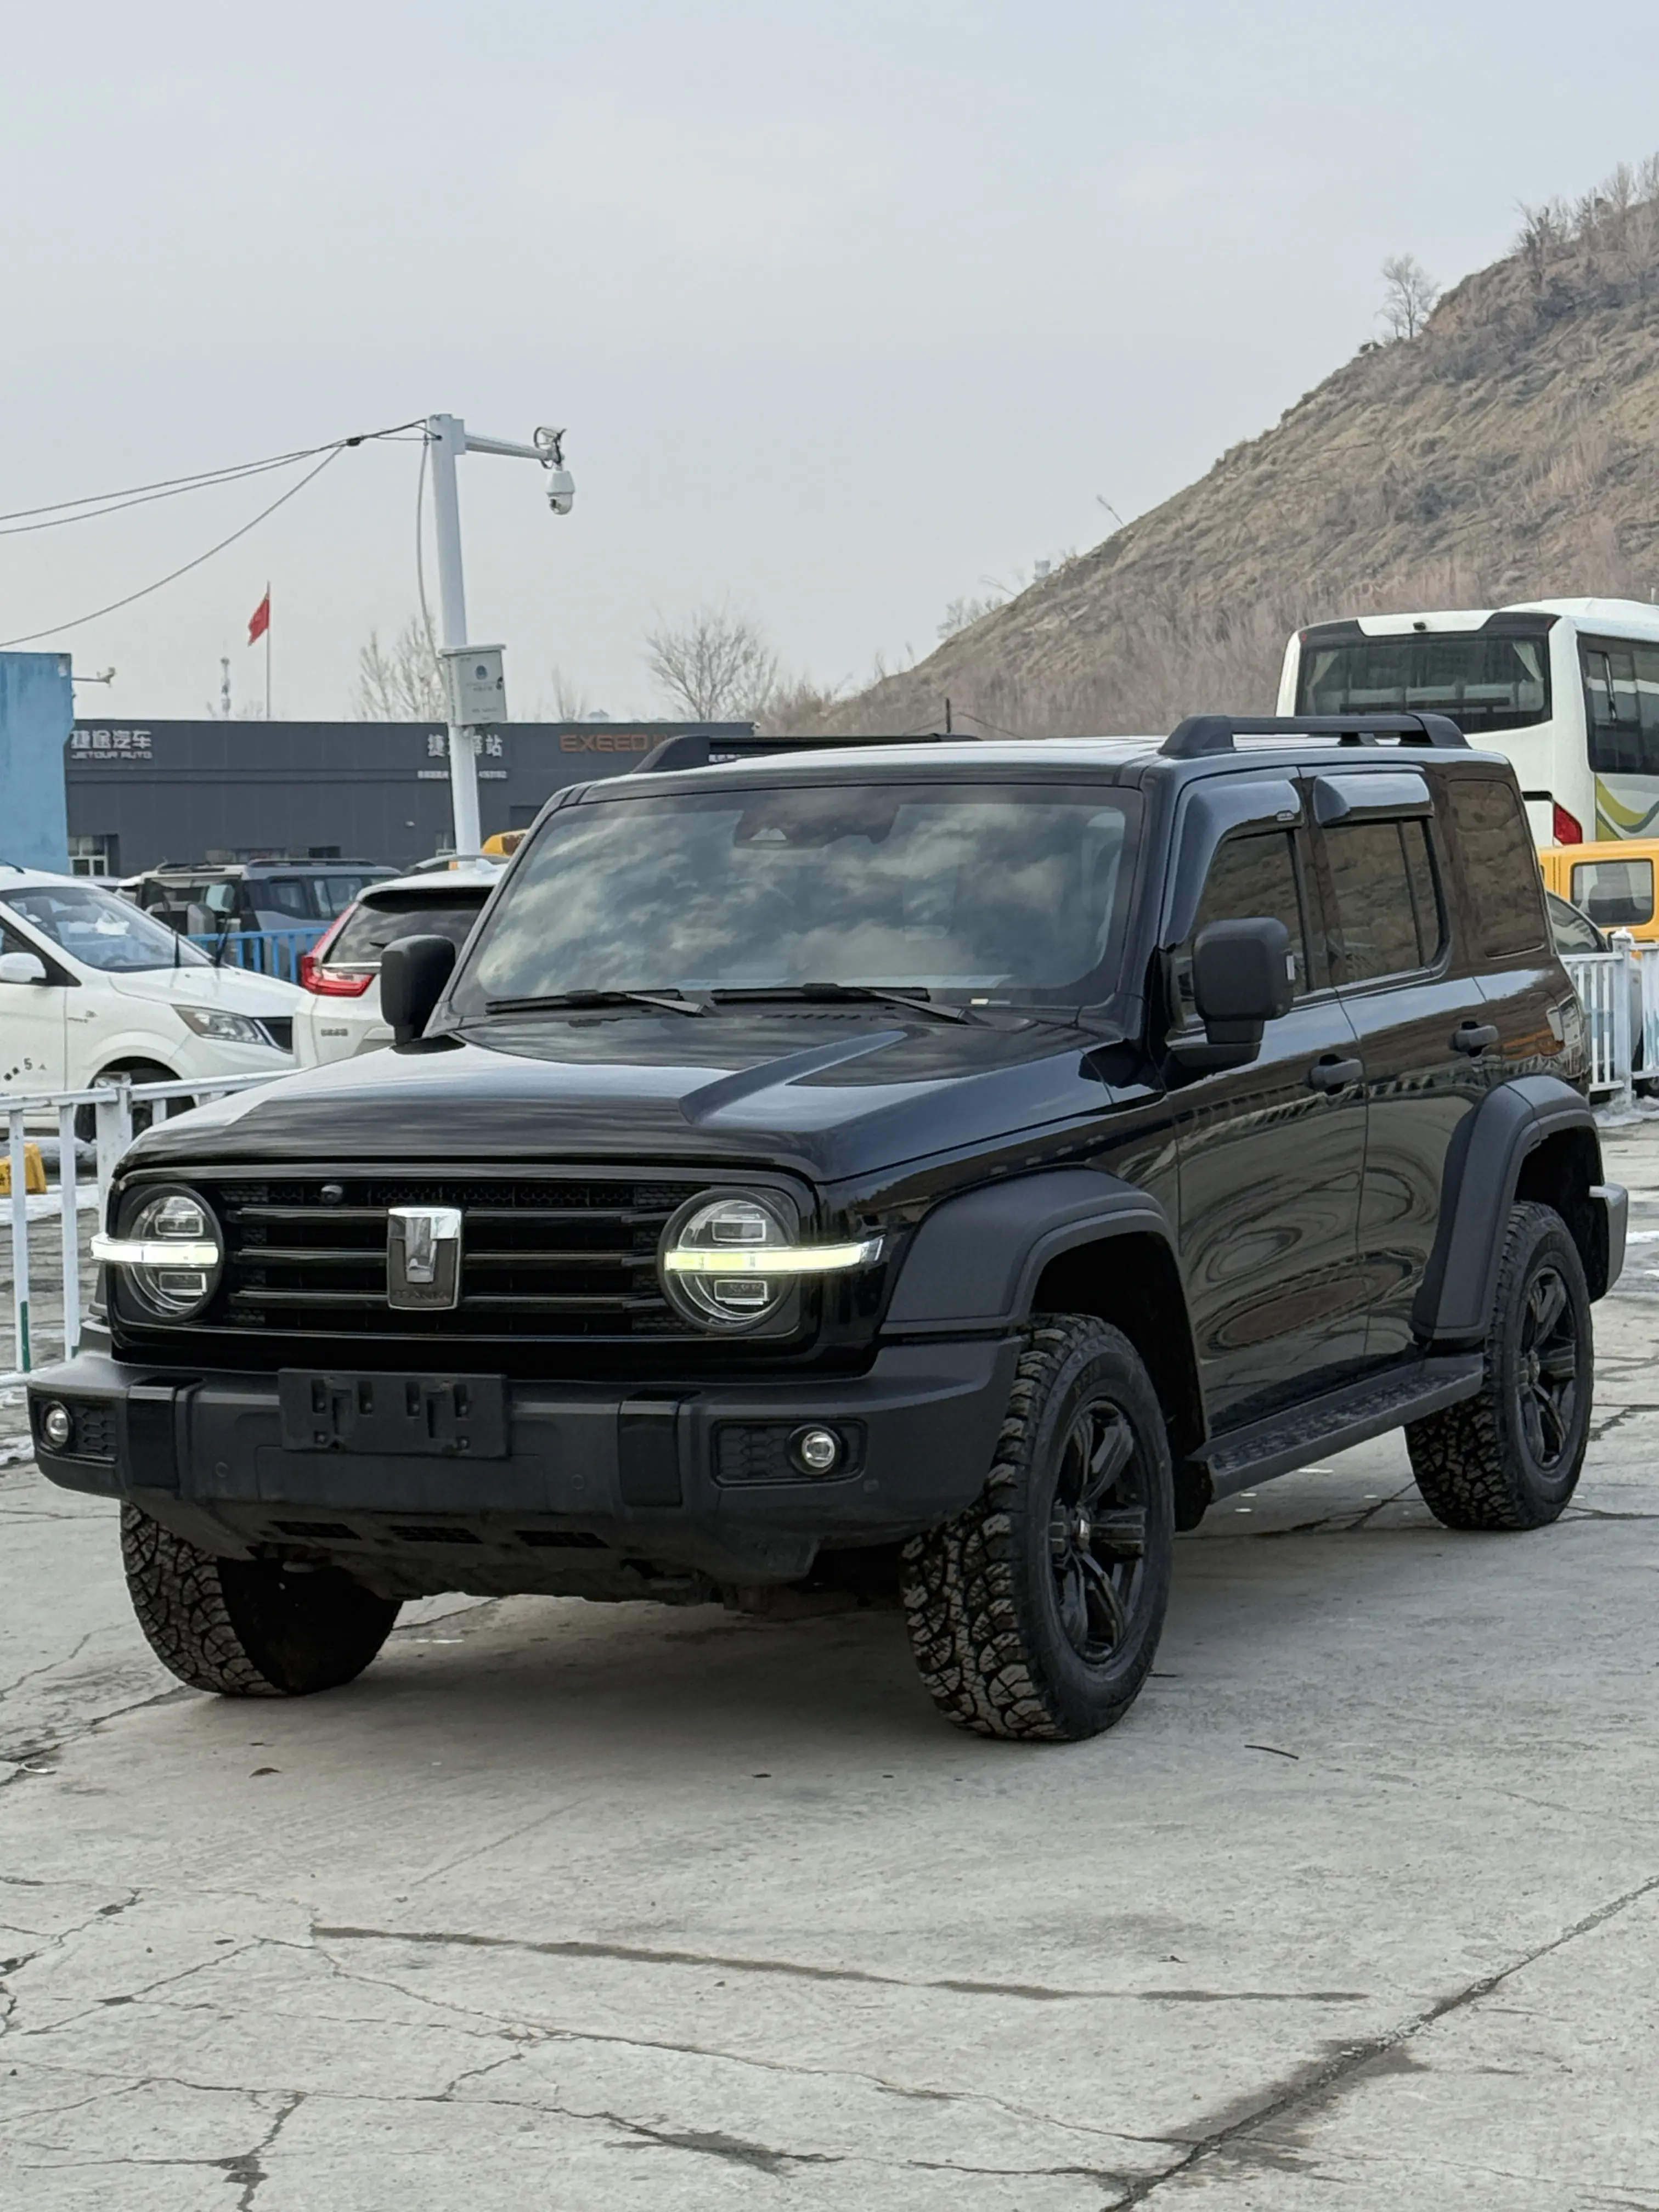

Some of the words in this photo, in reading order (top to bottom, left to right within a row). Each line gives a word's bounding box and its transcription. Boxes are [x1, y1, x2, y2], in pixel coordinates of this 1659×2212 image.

[560, 734, 648, 752] EXEED
[71, 751, 118, 759] JETOUR
[120, 751, 153, 759] AUTO
